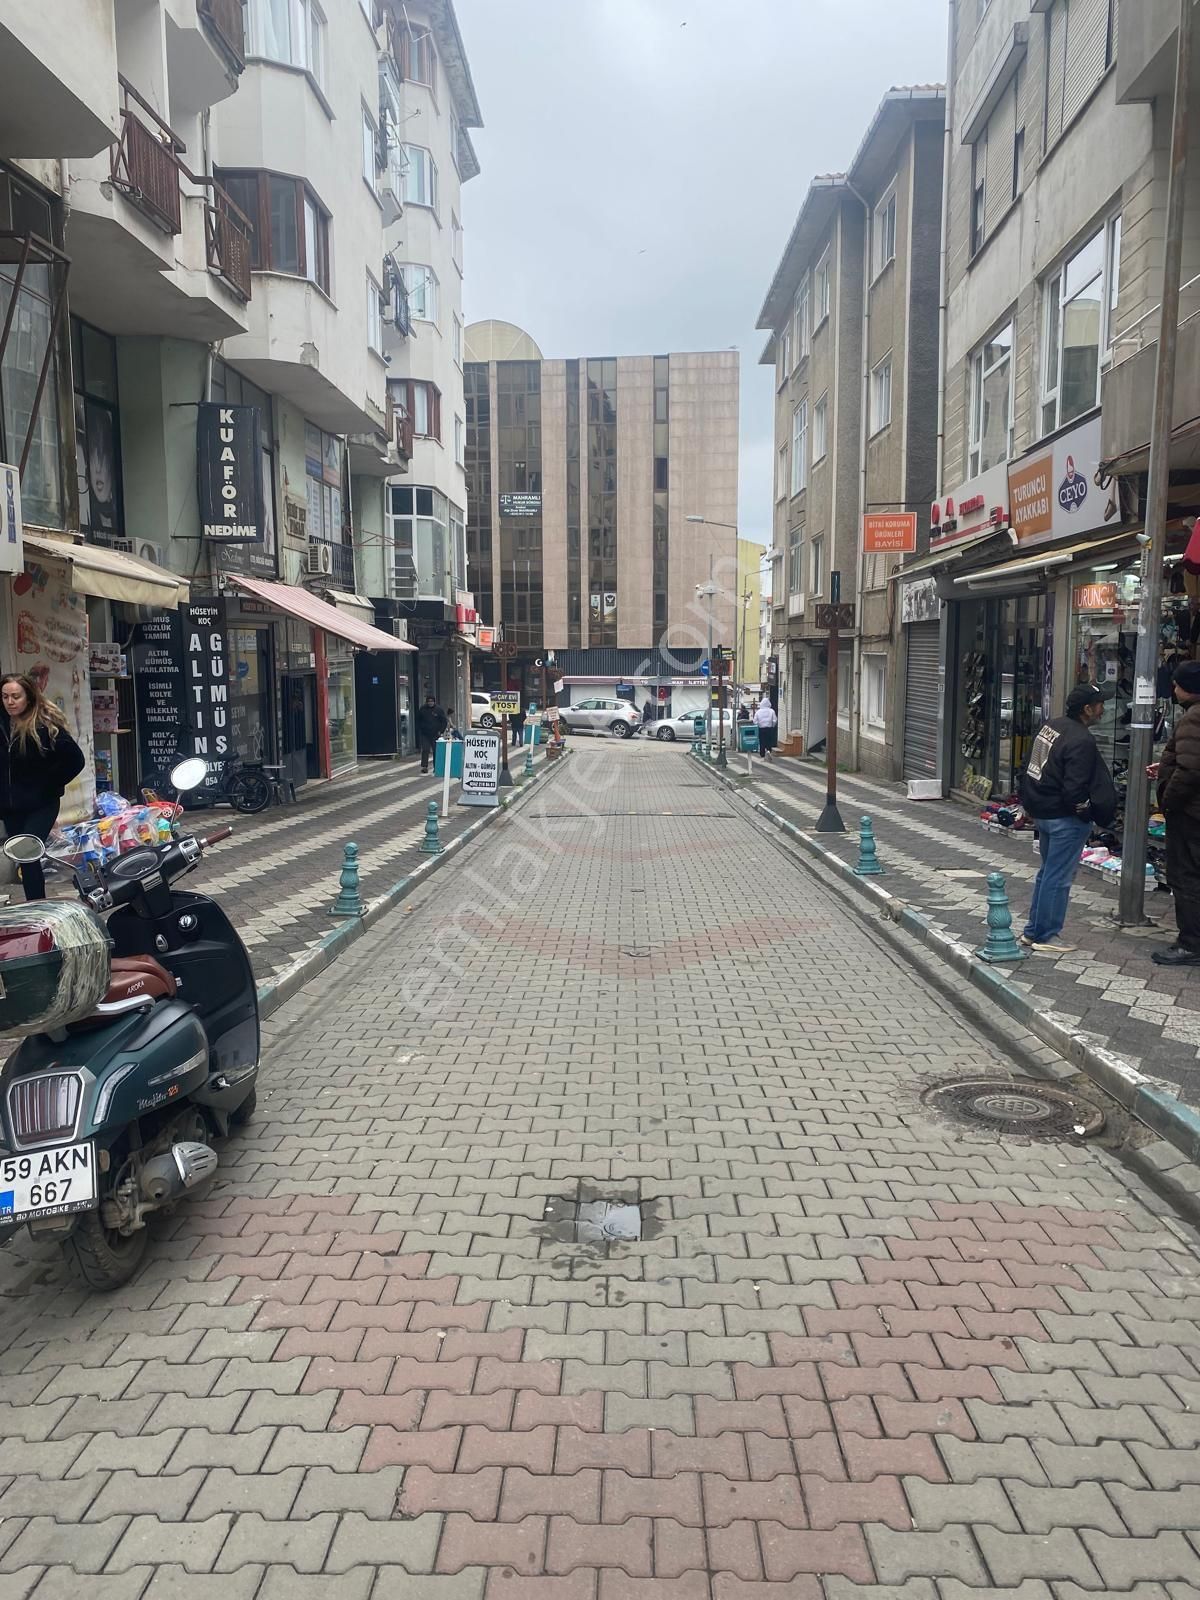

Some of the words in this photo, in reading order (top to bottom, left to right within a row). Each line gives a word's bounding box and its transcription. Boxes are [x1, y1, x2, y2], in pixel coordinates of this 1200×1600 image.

[219, 408, 237, 518] KUAFÖR
[1013, 474, 1046, 503] TURUNCU
[1060, 480, 1087, 504] CEYO
[1015, 496, 1049, 525] AYAKKABI
[203, 522, 257, 537] NEDİME
[885, 520, 911, 528] KORUMA
[874, 538, 904, 548] BAYİSİ
[1073, 583, 1116, 607] TURUNCU
[189, 606, 218, 616] HÜSEYİN
[198, 617, 211, 626] KOÇ
[145, 657, 173, 665] GÜMÜŞ
[148, 682, 172, 690] İSİMLİ
[189, 633, 208, 755] ALTIN
[209, 633, 228, 754] GÜMÜŞ
[466, 738, 497, 748] HÜSEYİN
[474, 750, 488, 761] KOÇ
[468, 771, 493, 779] ATÖLYESİ
[4, 1158, 31, 1182] 59
[38, 1146, 88, 1177] AKN
[30, 1178, 72, 1206] 667
[2, 1206, 12, 1214] TR
